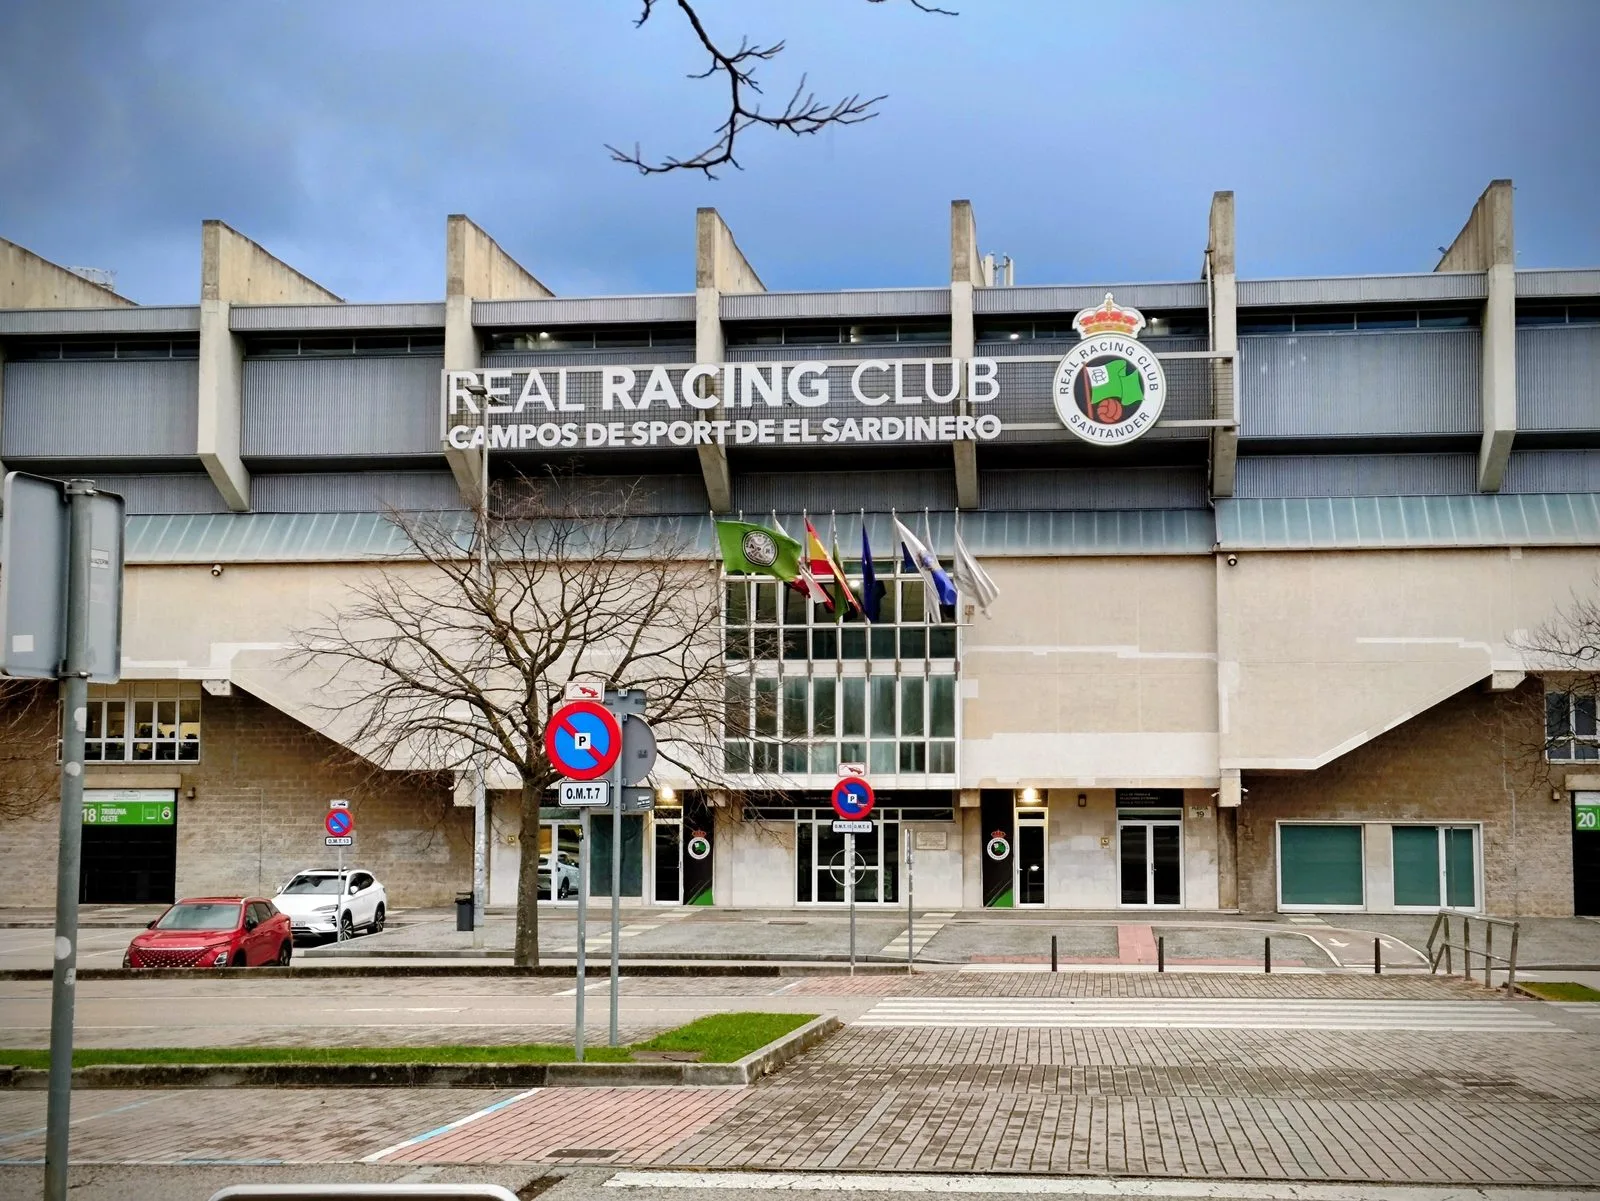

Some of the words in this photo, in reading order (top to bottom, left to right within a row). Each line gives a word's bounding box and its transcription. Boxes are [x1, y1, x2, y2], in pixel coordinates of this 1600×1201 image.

[1060, 361, 1080, 394] REAL
[1079, 341, 1135, 359] RACING
[1137, 356, 1159, 391] CLUB
[449, 368, 585, 414] REAL
[603, 361, 830, 411] RACING
[851, 358, 1000, 406] CLUB
[448, 422, 578, 450] CAMPOS
[586, 422, 625, 446] DE
[631, 420, 730, 446] SPORT
[736, 419, 775, 443] DE
[784, 418, 817, 442] EL
[822, 414, 1002, 442] SARDINERO
[1070, 411, 1150, 438] SANTANDER
[579, 736, 587, 746] P
[82, 808, 97, 822] 18
[1577, 812, 1596, 827] 20
